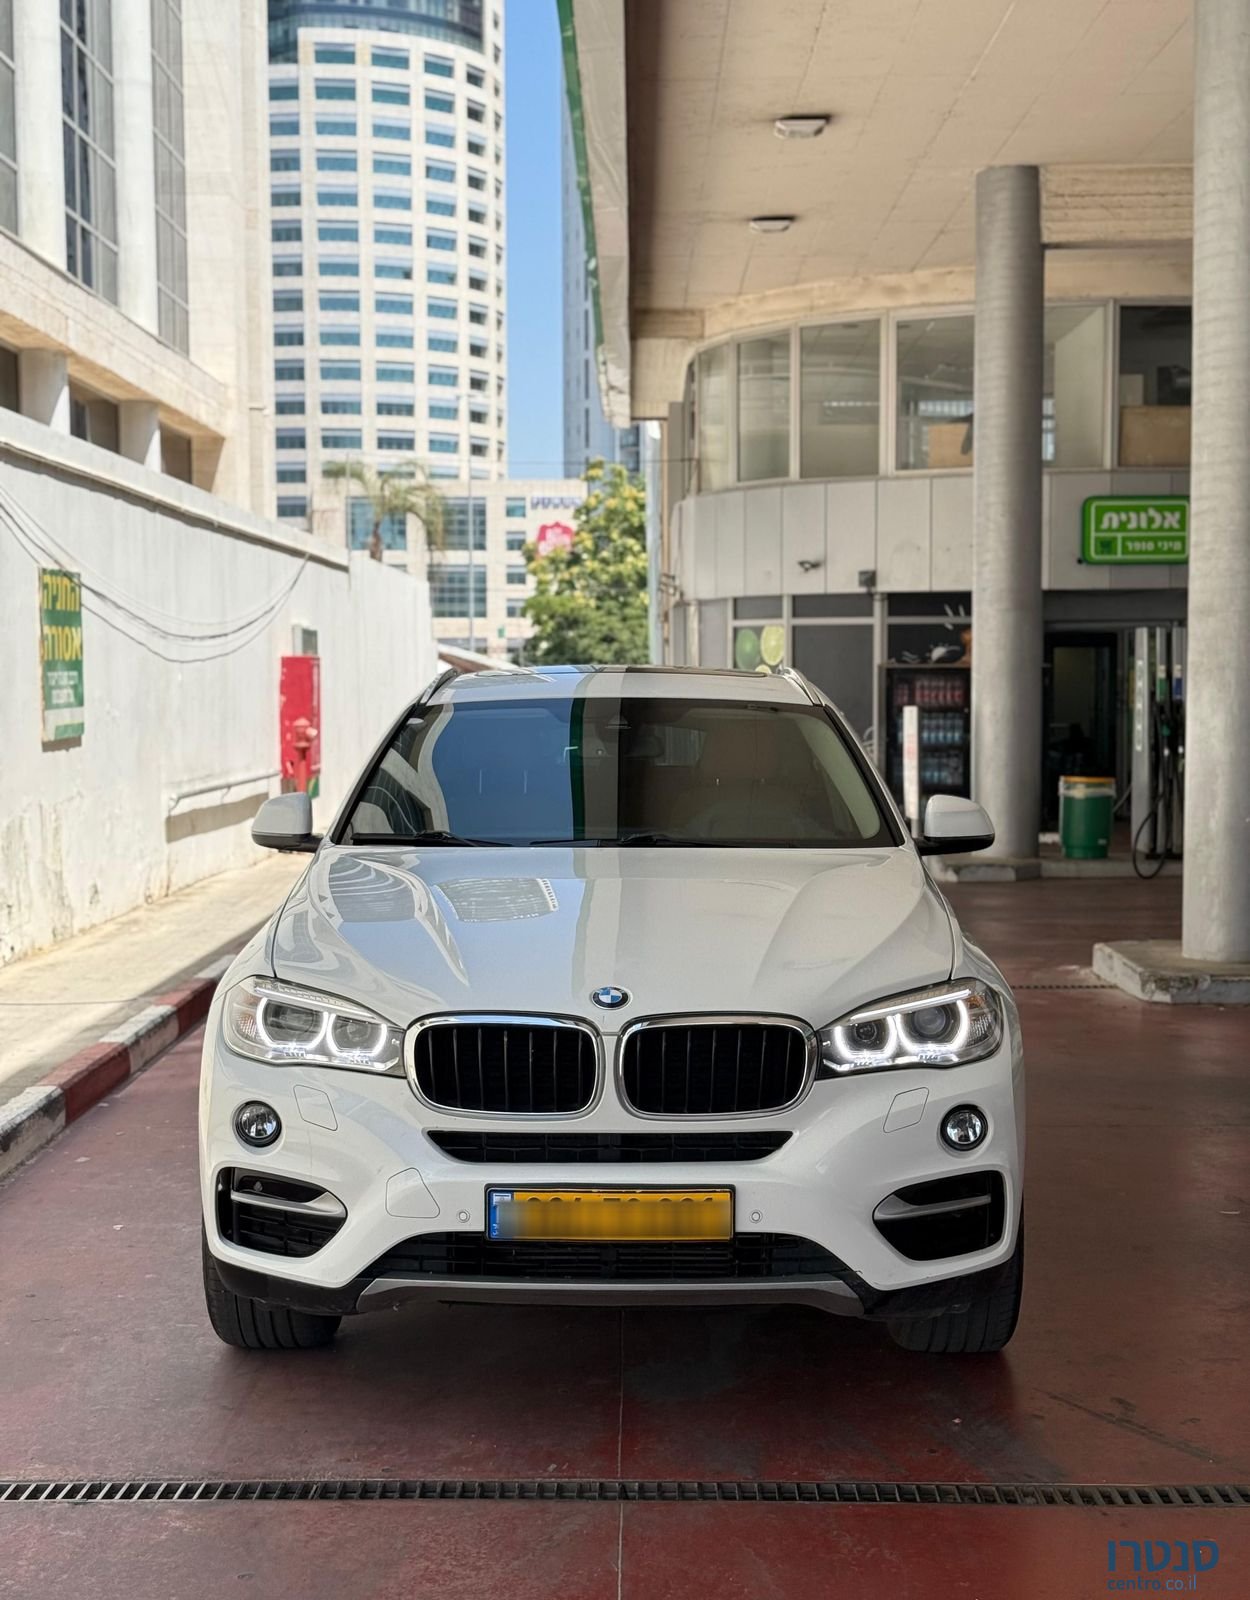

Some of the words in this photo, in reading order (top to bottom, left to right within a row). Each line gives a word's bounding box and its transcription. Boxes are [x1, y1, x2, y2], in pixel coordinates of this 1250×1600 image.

[1100, 506, 1181, 530] אלונית
[1126, 541, 1155, 551] סופר
[1157, 541, 1182, 551] מיני
[43, 575, 80, 611] החניה
[43, 624, 82, 661] אסורה
